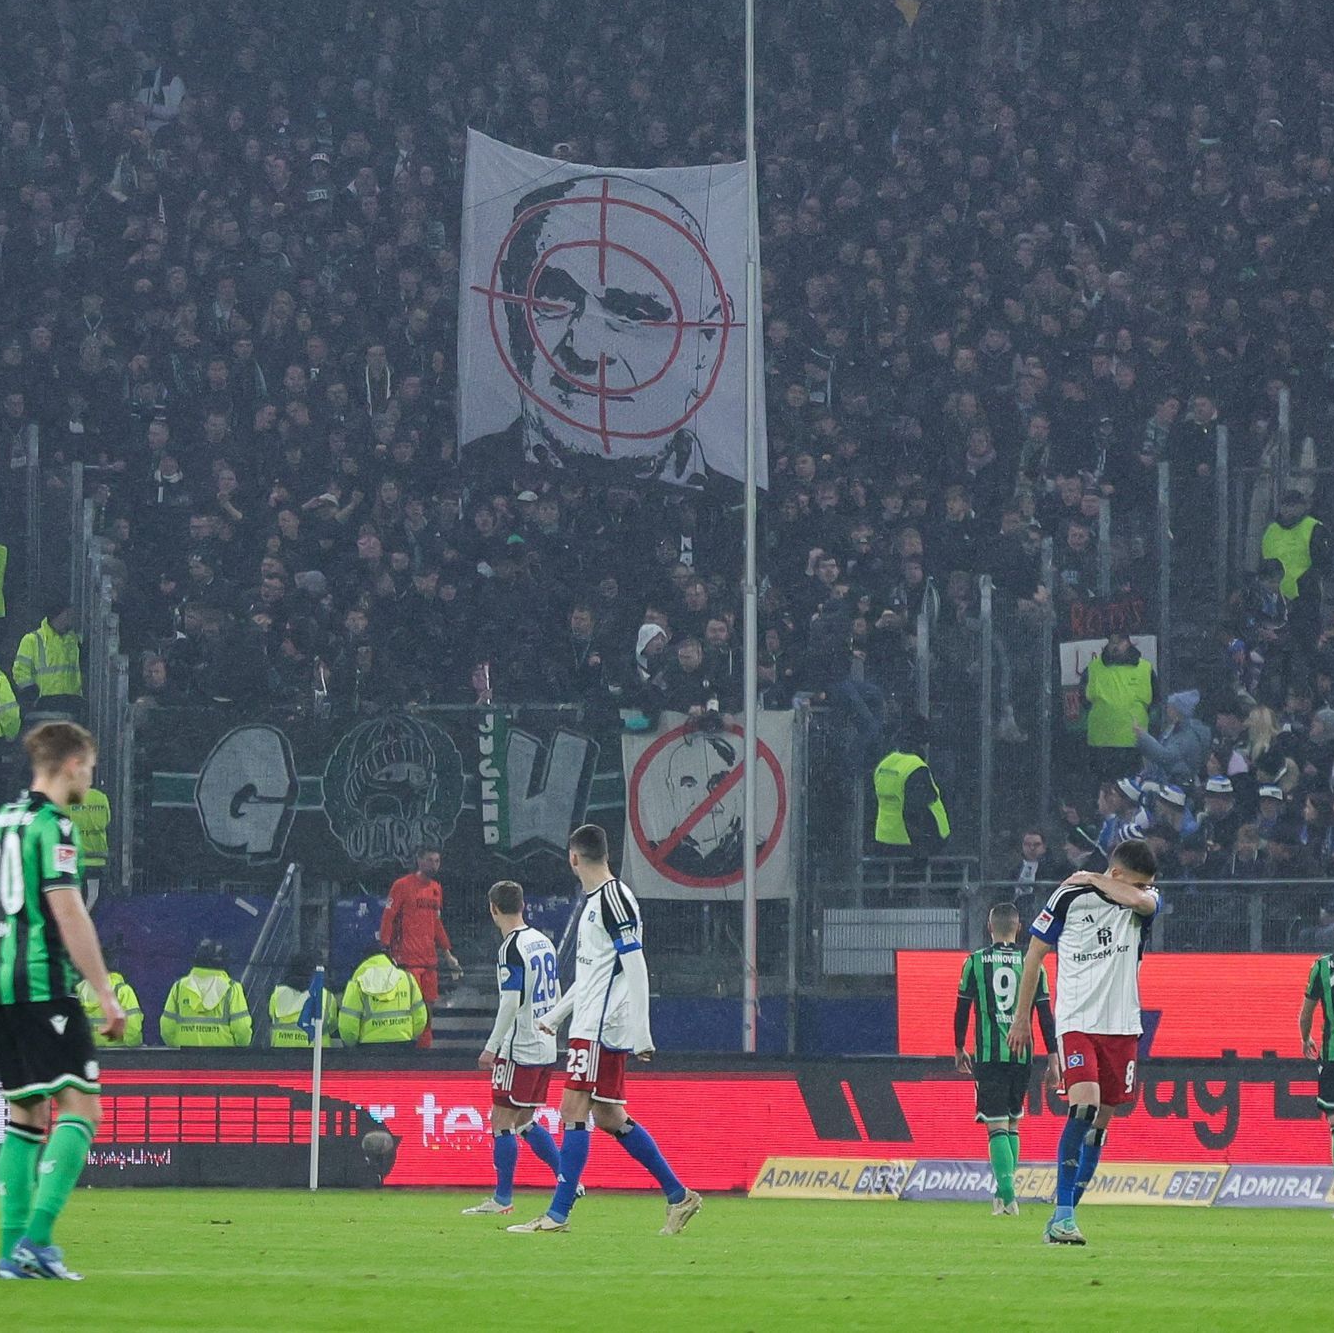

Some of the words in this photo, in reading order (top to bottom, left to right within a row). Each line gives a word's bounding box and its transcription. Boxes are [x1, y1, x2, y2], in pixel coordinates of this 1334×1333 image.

[981, 954, 1022, 965] HANNOVER
[530, 952, 558, 1004] 28
[992, 966, 1017, 1011] 9
[566, 1047, 589, 1074] 23
[1125, 1060, 1135, 1093] 8
[757, 1167, 851, 1192] ADMIRAL
[905, 1168, 999, 1194] ADMIRA
[1085, 1174, 1160, 1197] DMIRAL
[1167, 1171, 1218, 1197] BET
[1218, 1173, 1324, 1200] ADMIRAL
